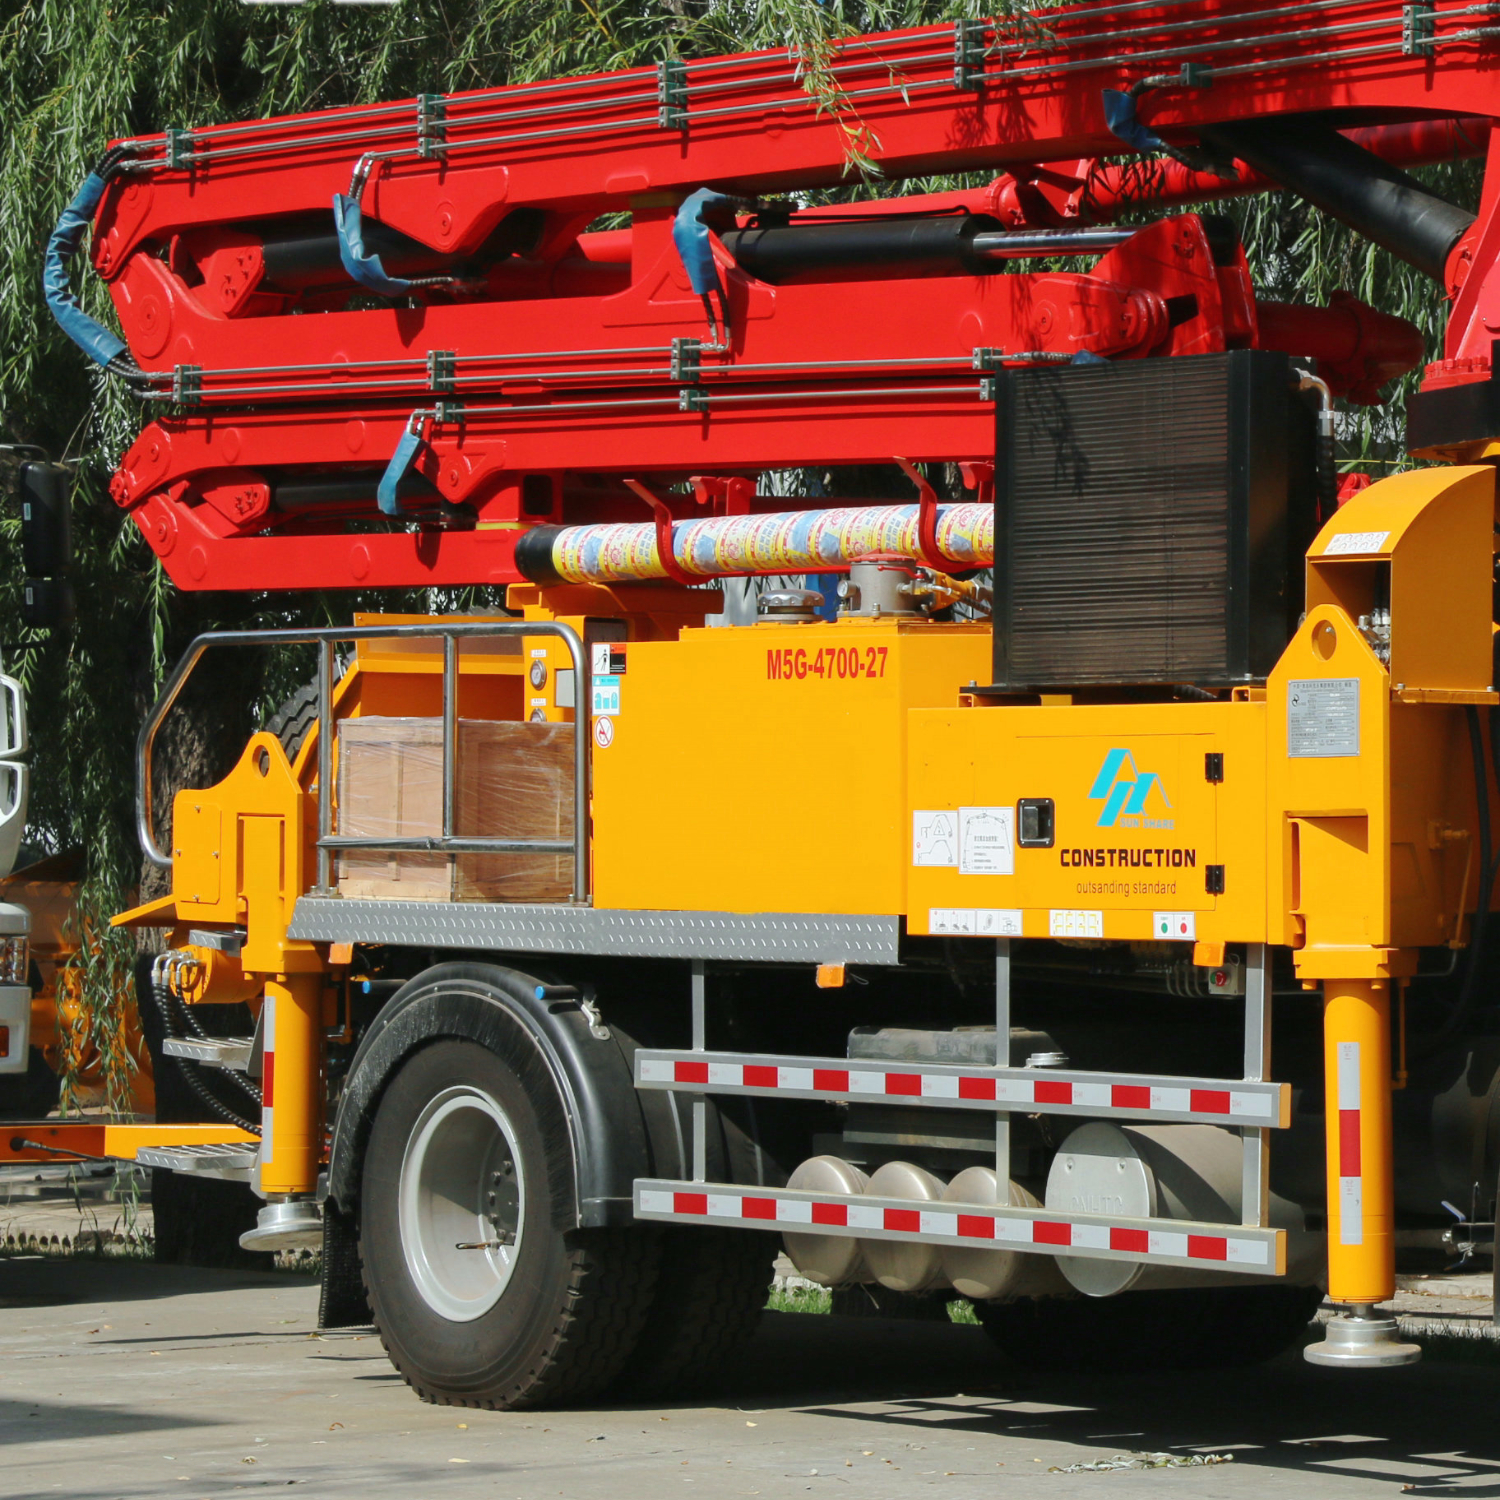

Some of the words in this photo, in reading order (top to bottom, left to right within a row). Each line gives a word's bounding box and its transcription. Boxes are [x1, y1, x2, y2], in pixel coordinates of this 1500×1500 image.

[766, 647, 888, 680] M5G-4700-27
[1120, 817, 1140, 828] SUN
[1143, 818, 1175, 830] SHARE
[1060, 848, 1196, 868] CONSTRUCTION
[1076, 880, 1130, 897] outsanding
[1132, 880, 1176, 895] standard
